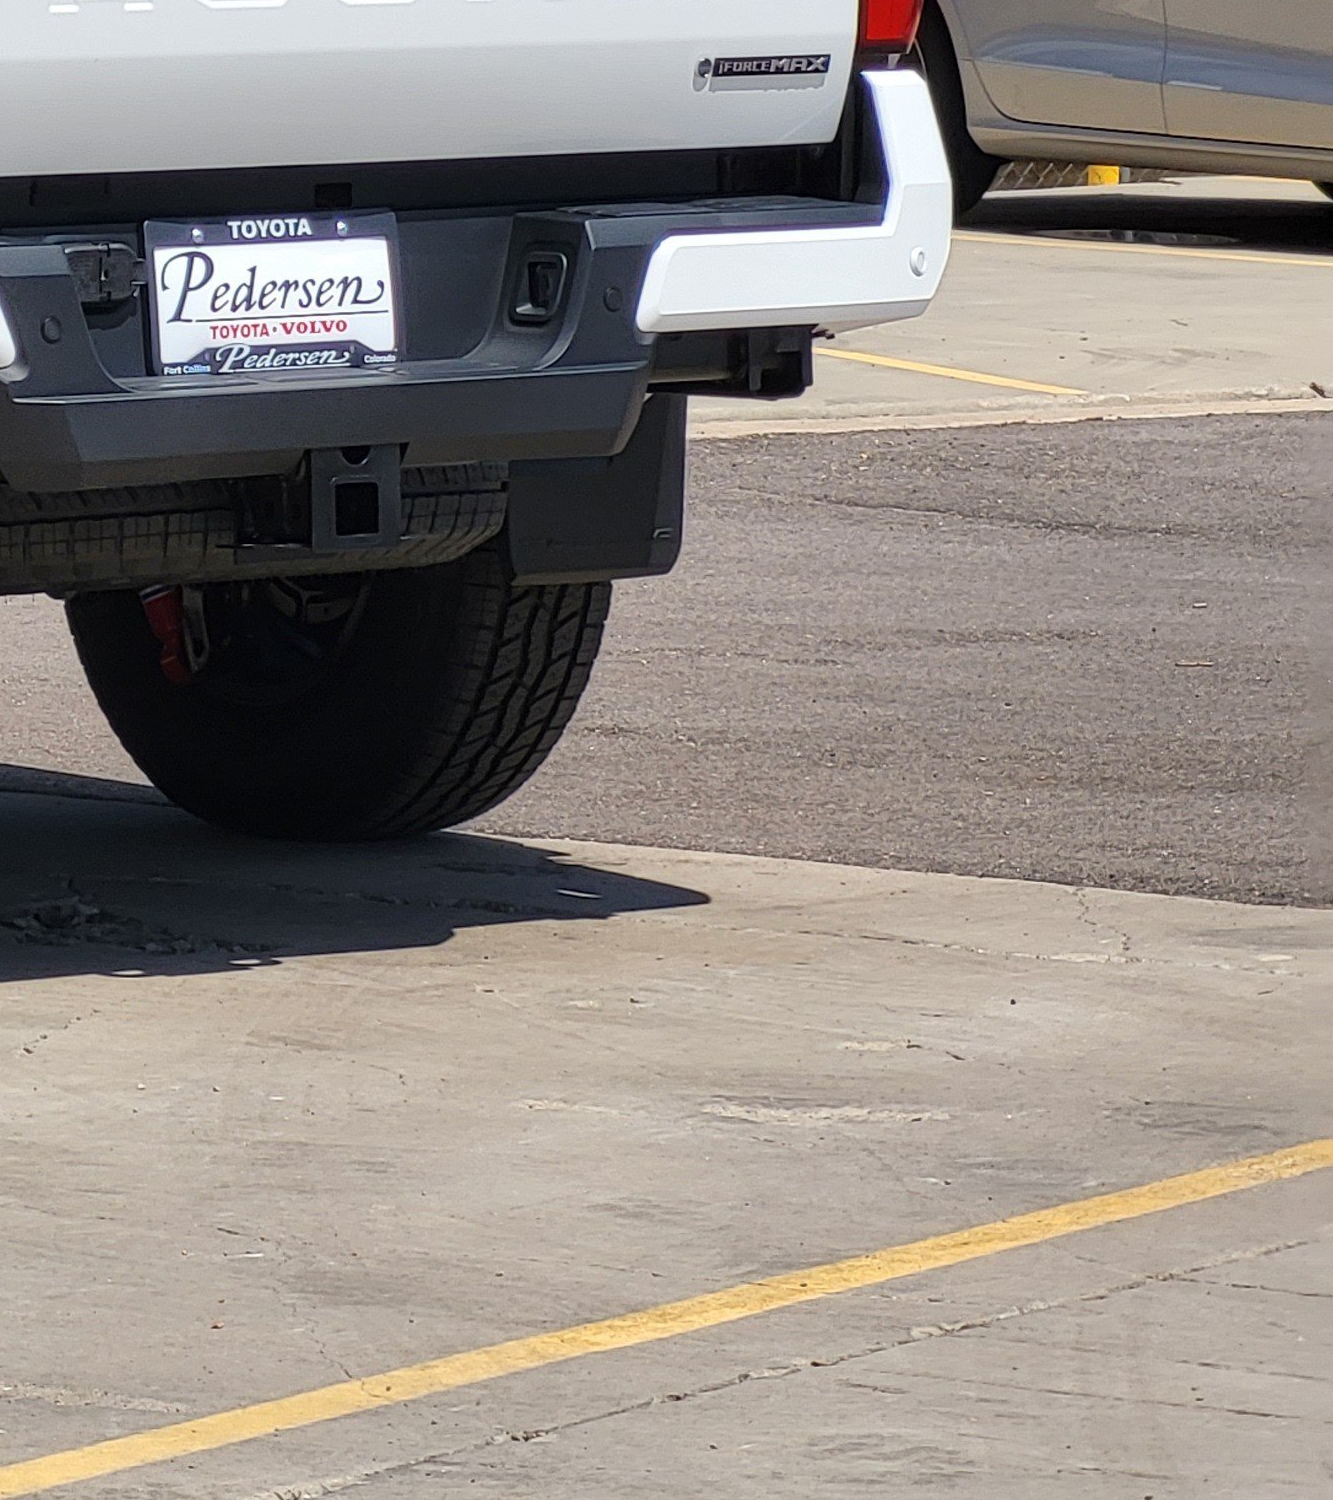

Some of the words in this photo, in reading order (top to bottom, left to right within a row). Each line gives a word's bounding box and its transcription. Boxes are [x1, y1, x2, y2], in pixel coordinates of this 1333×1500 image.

[227, 218, 313, 239] TOYOTA
[161, 251, 384, 324] Pedersen
[209, 323, 270, 340] TOYOTA
[280, 320, 348, 336] VOLVO
[215, 343, 351, 374] Pedersen
